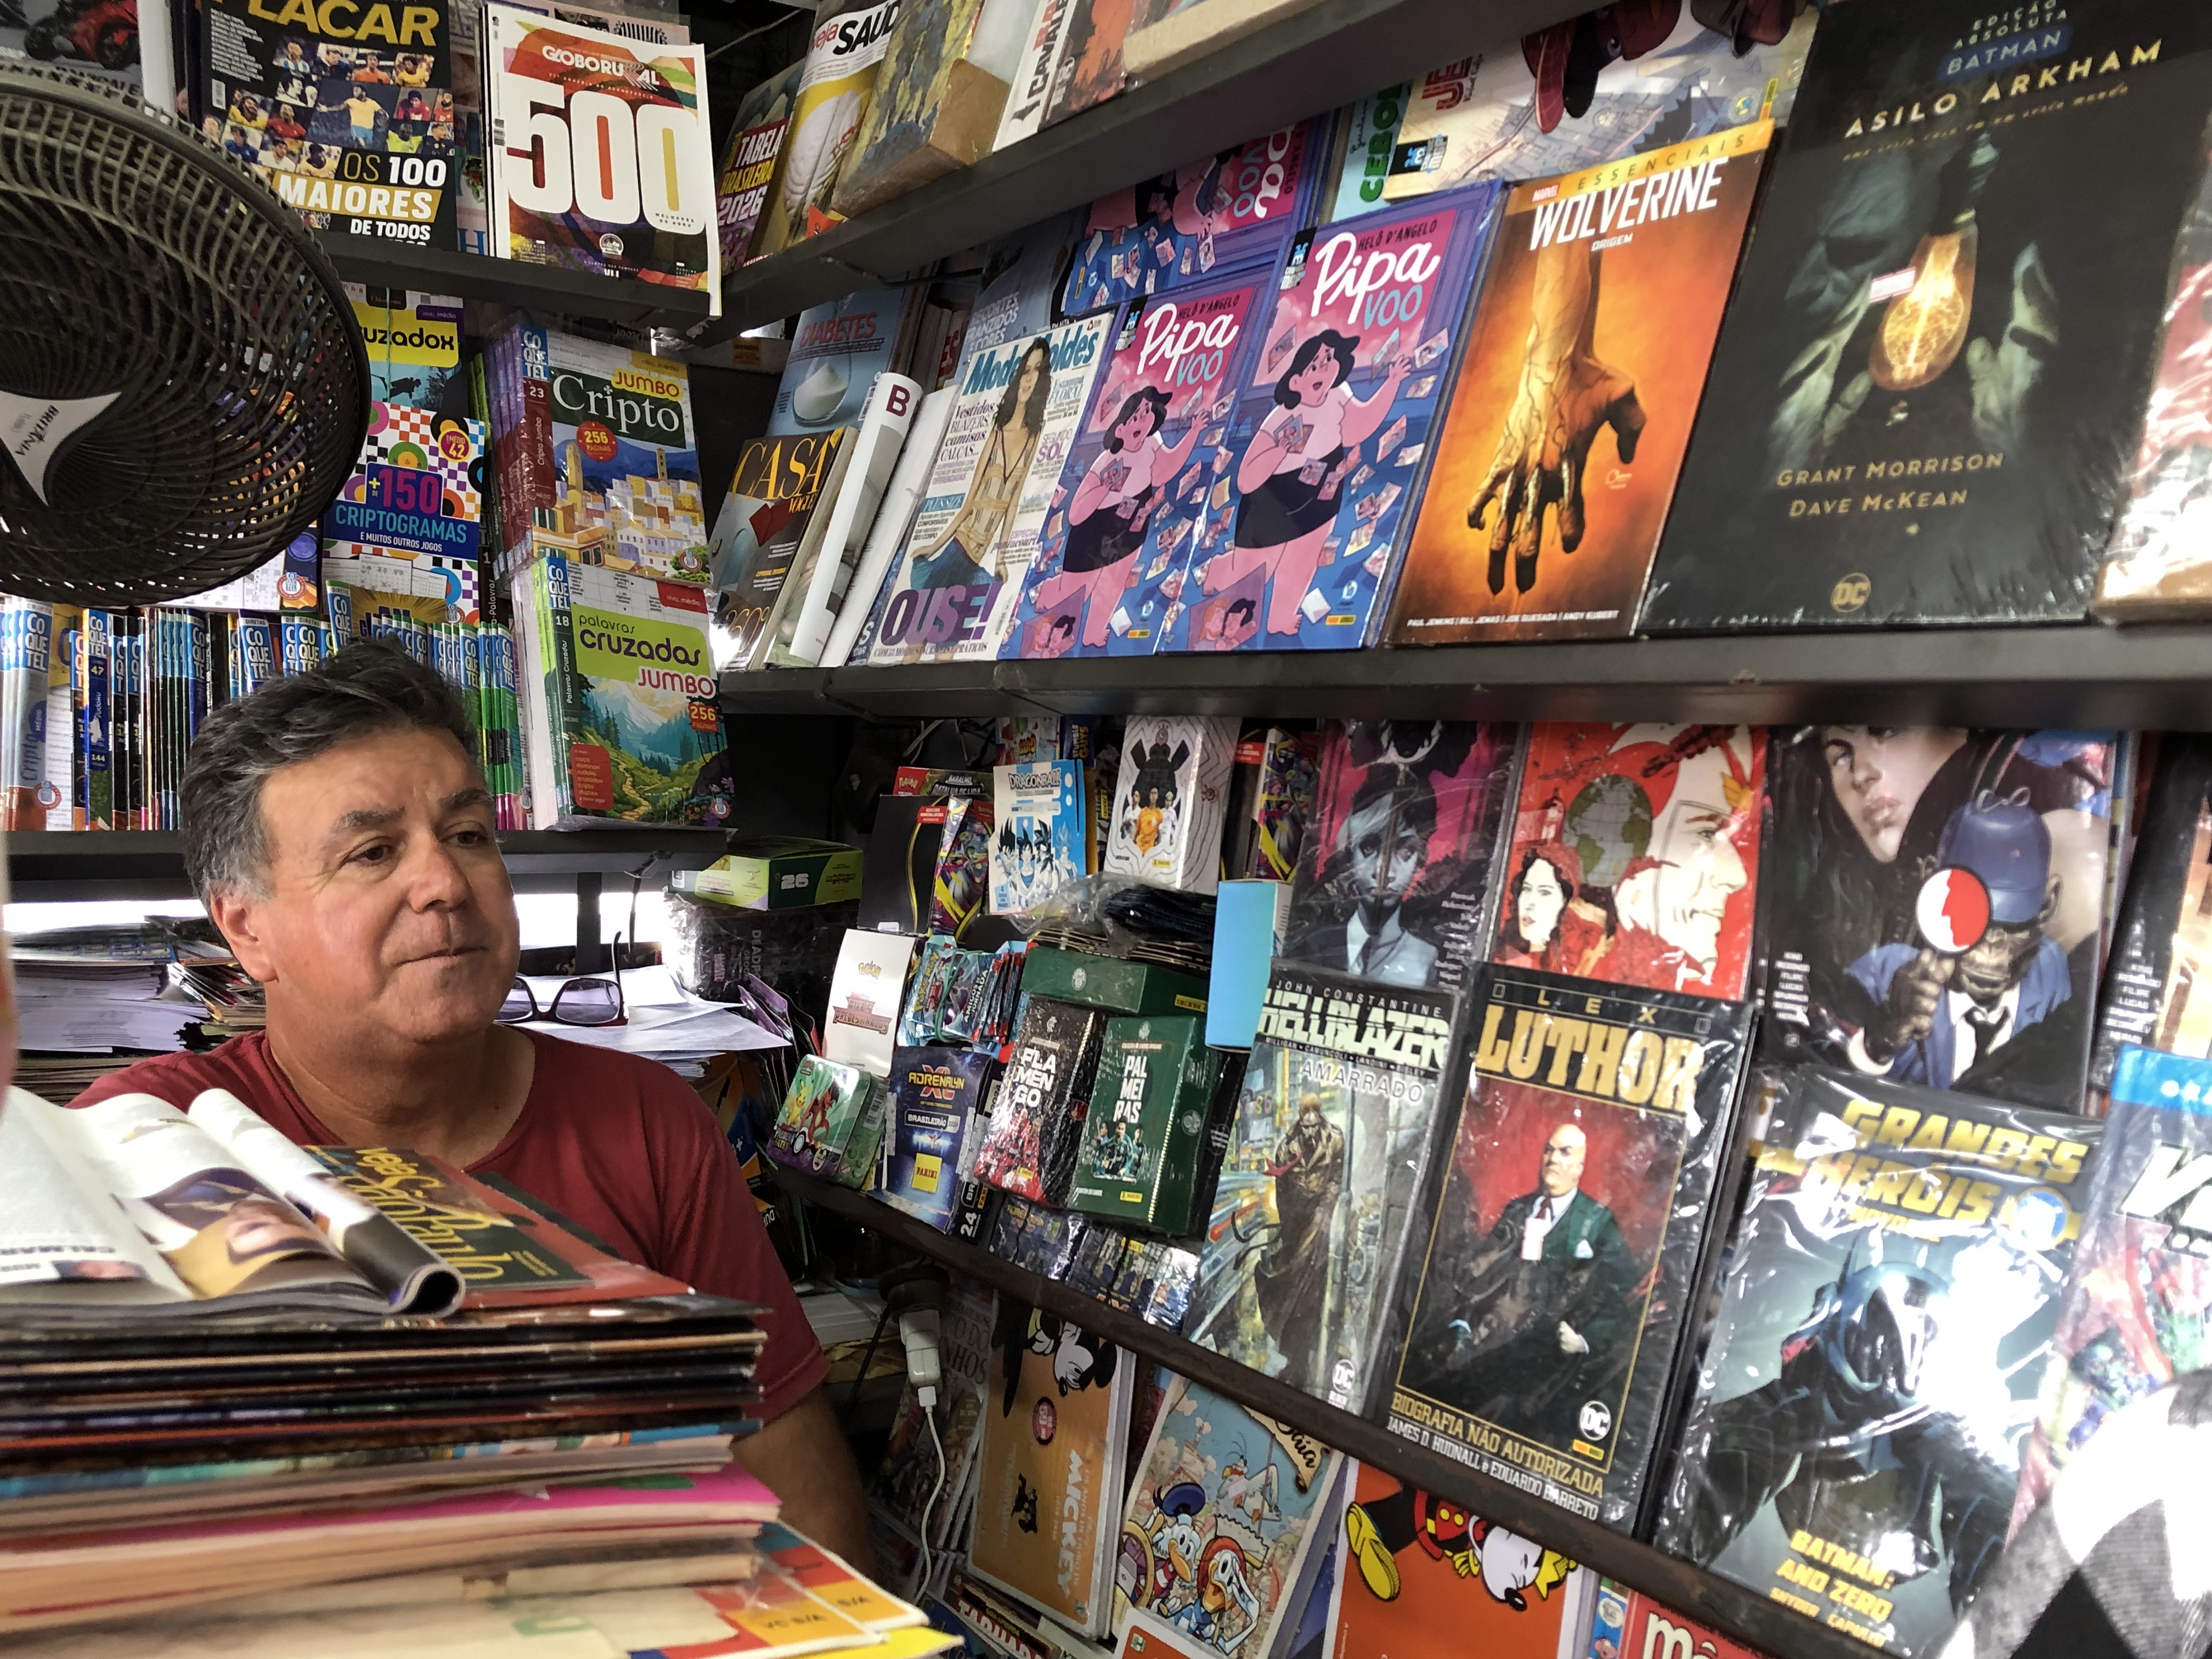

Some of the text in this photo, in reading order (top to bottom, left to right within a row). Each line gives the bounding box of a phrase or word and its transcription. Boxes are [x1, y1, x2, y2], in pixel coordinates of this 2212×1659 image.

[214, 0, 439, 47] LACAR
[1953, 9, 2068, 50] ABSOLUTA
[1947, 30, 2062, 76] BATMAN
[1844, 38, 2163, 139] ASILO ARKHAM
[505, 73, 706, 235] 500
[735, 125, 785, 168] TABELA
[344, 152, 447, 187] OS 100
[1577, 133, 1745, 190] ESSENCIAIS
[1233, 143, 1268, 217] VOO
[278, 174, 432, 220] MAIORES
[1530, 156, 1730, 251] WOLVERINE
[1532, 184, 1559, 201] MARVEL
[718, 185, 768, 227] 2026
[350, 219, 431, 240] DE TODOS
[1358, 219, 1438, 251] HELÔ D'ANGELO
[1591, 233, 1633, 252] ORIGEM
[1311, 231, 1441, 325] Pipa
[1199, 295, 1240, 315] D'ANGELO
[1363, 285, 1423, 330] VOO
[359, 327, 455, 351] uzadox
[523, 330, 543, 349] CO
[799, 311, 878, 349] DIABETES
[1137, 303, 1240, 383] Pipa
[523, 348, 548, 366] QUE
[1177, 349, 1223, 387] VOO
[524, 364, 548, 381] TEL
[529, 387, 545, 398] 23
[614, 371, 681, 399] JUMBO
[552, 374, 680, 435] Cripto
[885, 384, 912, 417] B
[584, 430, 608, 444] 256
[449, 444, 465, 458] 42
[537, 442, 545, 466] Cripto
[1036, 442, 1064, 464] SOL
[730, 434, 830, 503] CASA
[1776, 452, 2006, 489] GRANT MORRISON
[378, 467, 439, 515] 150
[1789, 497, 1851, 520] DAVE
[335, 504, 467, 544] CRIPTOGRAMAS
[360, 532, 443, 552] E MUITOS OUTROS JOGOS
[549, 565, 563, 580] CO
[548, 578, 569, 596] QUE
[333, 596, 348, 615] CO
[550, 594, 571, 610] TEL
[881, 580, 1004, 646] OUSE!
[27, 613, 46, 634] CO
[89, 617, 104, 632] CO
[335, 614, 351, 631] QUE
[556, 615, 569, 627] 18
[579, 615, 635, 634] palavras
[25, 633, 48, 653] QUE
[89, 631, 107, 646] QUE
[245, 627, 263, 646] CO
[299, 626, 315, 645] CO
[465, 638, 477, 654] CO
[501, 639, 511, 654] CO
[89, 644, 107, 658] TEL
[247, 646, 272, 663] QUE
[298, 645, 320, 663] QUE
[580, 629, 701, 667] cruzadas
[26, 650, 47, 671] TEL
[91, 666, 104, 675] 47
[465, 654, 478, 672] QUE
[501, 655, 514, 673] QUE
[504, 670, 515, 689] TEL
[638, 668, 714, 696] JUMBO
[690, 706, 716, 721] 256
[1078, 725, 1090, 759] GUYS
[91, 754, 106, 763] 144
[781, 873, 809, 890] 26
[970, 969, 989, 1013] JORNADA
[1276, 980, 1443, 1018] JOHN CONSTANTINE
[1538, 990, 1656, 1024] LEX
[1256, 988, 1450, 1071] HELLBLAZER
[1124, 1055, 1148, 1079] PAL
[1476, 1004, 1704, 1113] LUTHOR
[908, 1071, 964, 1090] ADRENALYN
[1015, 1066, 1054, 1092] MEN
[1120, 1078, 1145, 1101] MEI
[1299, 1058, 1425, 1104] AMARRADO
[1015, 1084, 1042, 1108] GO
[907, 1114, 947, 1127] BRASILEIRÃO
[1113, 1100, 1142, 1124] RAS
[1842, 1099, 2091, 1185] GRANDES
[354, 1147, 419, 1177] veja
[916, 1166, 938, 1180] PANINI
[960, 1212, 978, 1237] 24
[1390, 1391, 1604, 1500] BIOGRAFIA NÃO AUTORIZADA
[1387, 1415, 1420, 1445] JAMES
[1431, 1431, 1480, 1471] HUDNALL
[1481, 1459, 1489, 1474] e
[1489, 1463, 1542, 1497] EDUARDO
[1543, 1482, 1599, 1521] BARRETO
[1057, 1449, 1084, 1598] MICKEY
[1790, 1530, 1896, 1590] BATMAN:
[1777, 1559, 1894, 1624] ANO ZERO
